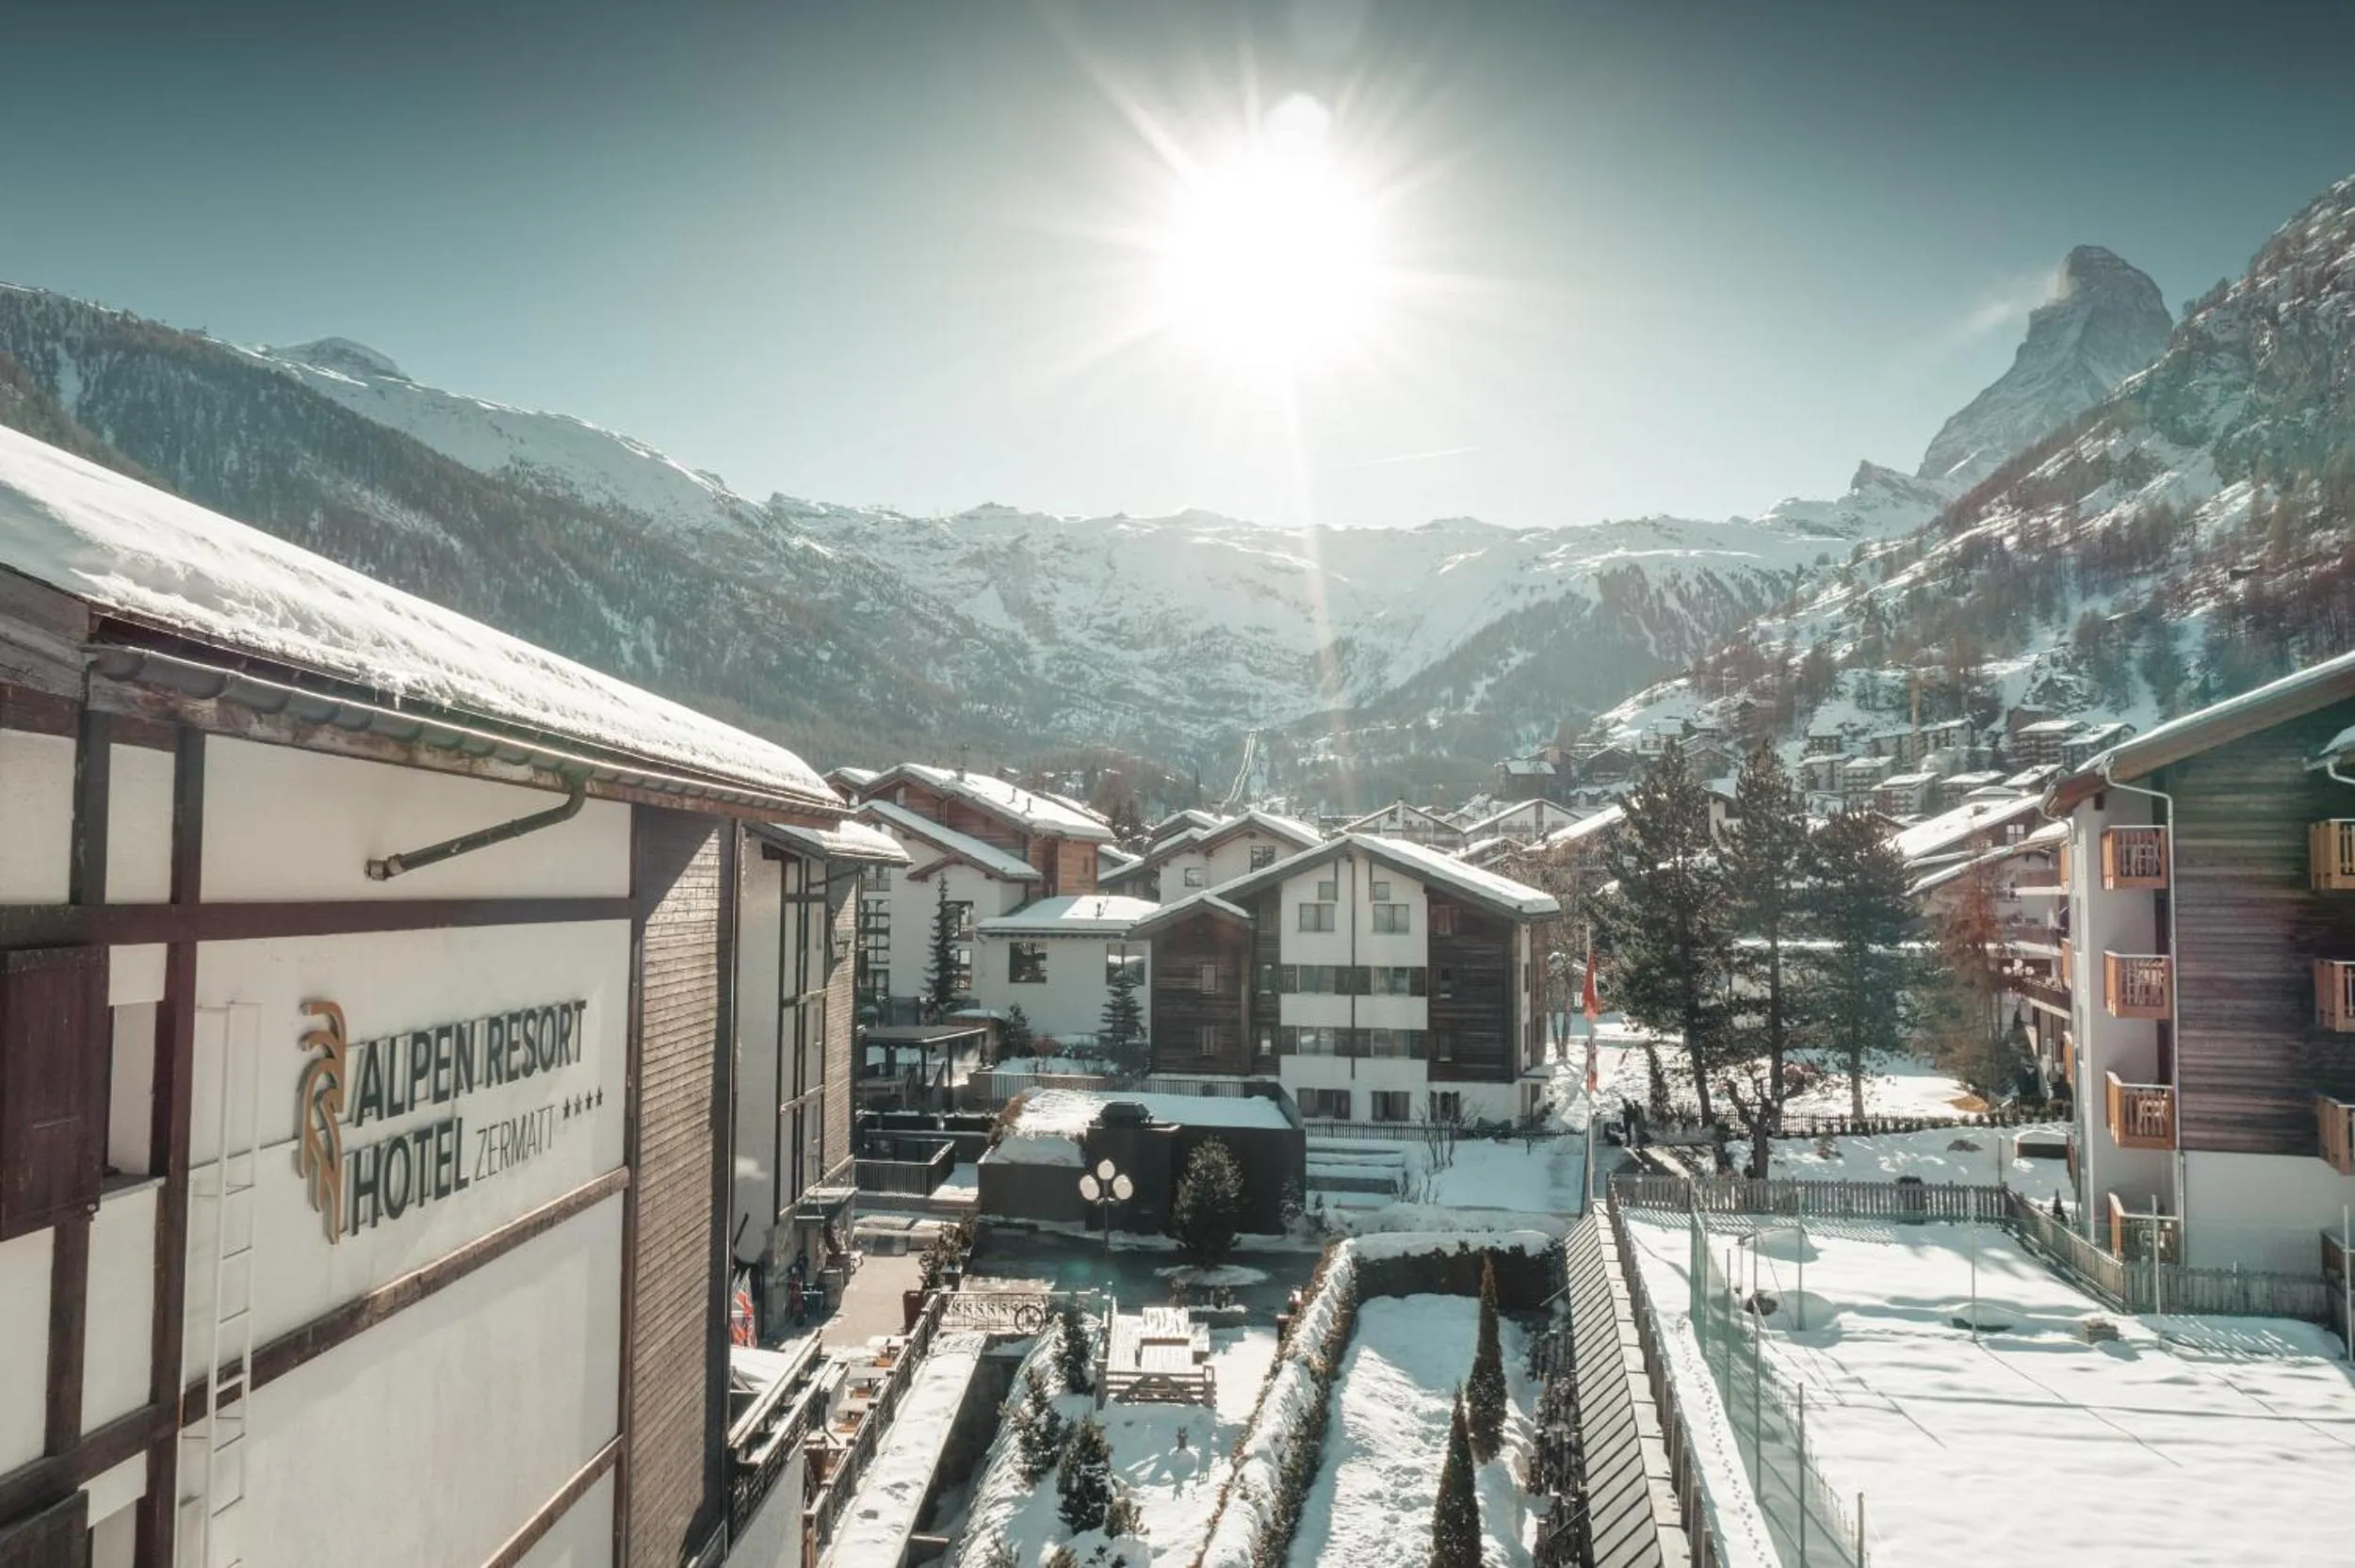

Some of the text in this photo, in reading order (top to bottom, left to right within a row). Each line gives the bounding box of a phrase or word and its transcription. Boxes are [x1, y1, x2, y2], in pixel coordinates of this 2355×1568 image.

[354, 999, 587, 1128] ALPEN RESORT
[351, 1104, 556, 1237] HOTEL ZERMATT
